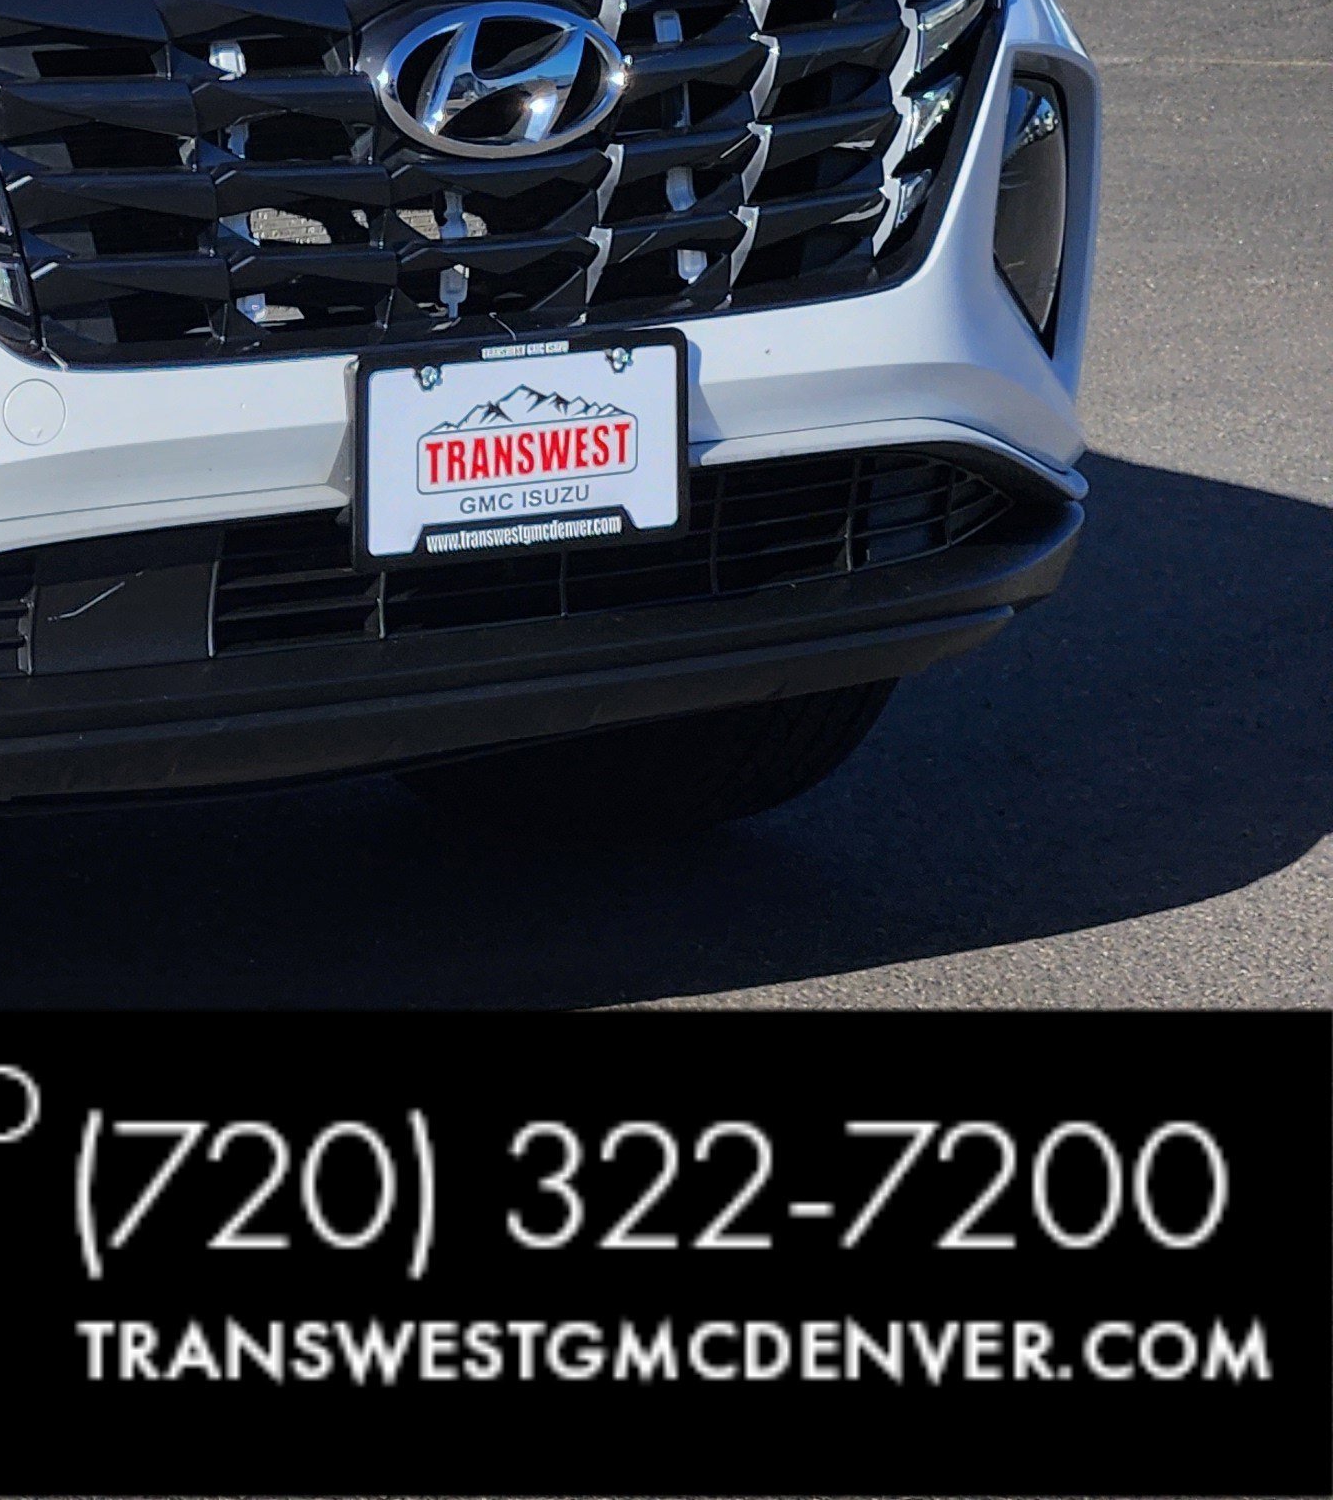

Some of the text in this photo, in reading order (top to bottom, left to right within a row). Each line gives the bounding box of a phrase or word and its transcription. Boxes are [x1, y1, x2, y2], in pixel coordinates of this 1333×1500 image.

[425, 422, 631, 485] TRANSWEST
[459, 484, 590, 515] GMC ISUZU
[426, 515, 623, 555] www.transwestgmcdenver.com
